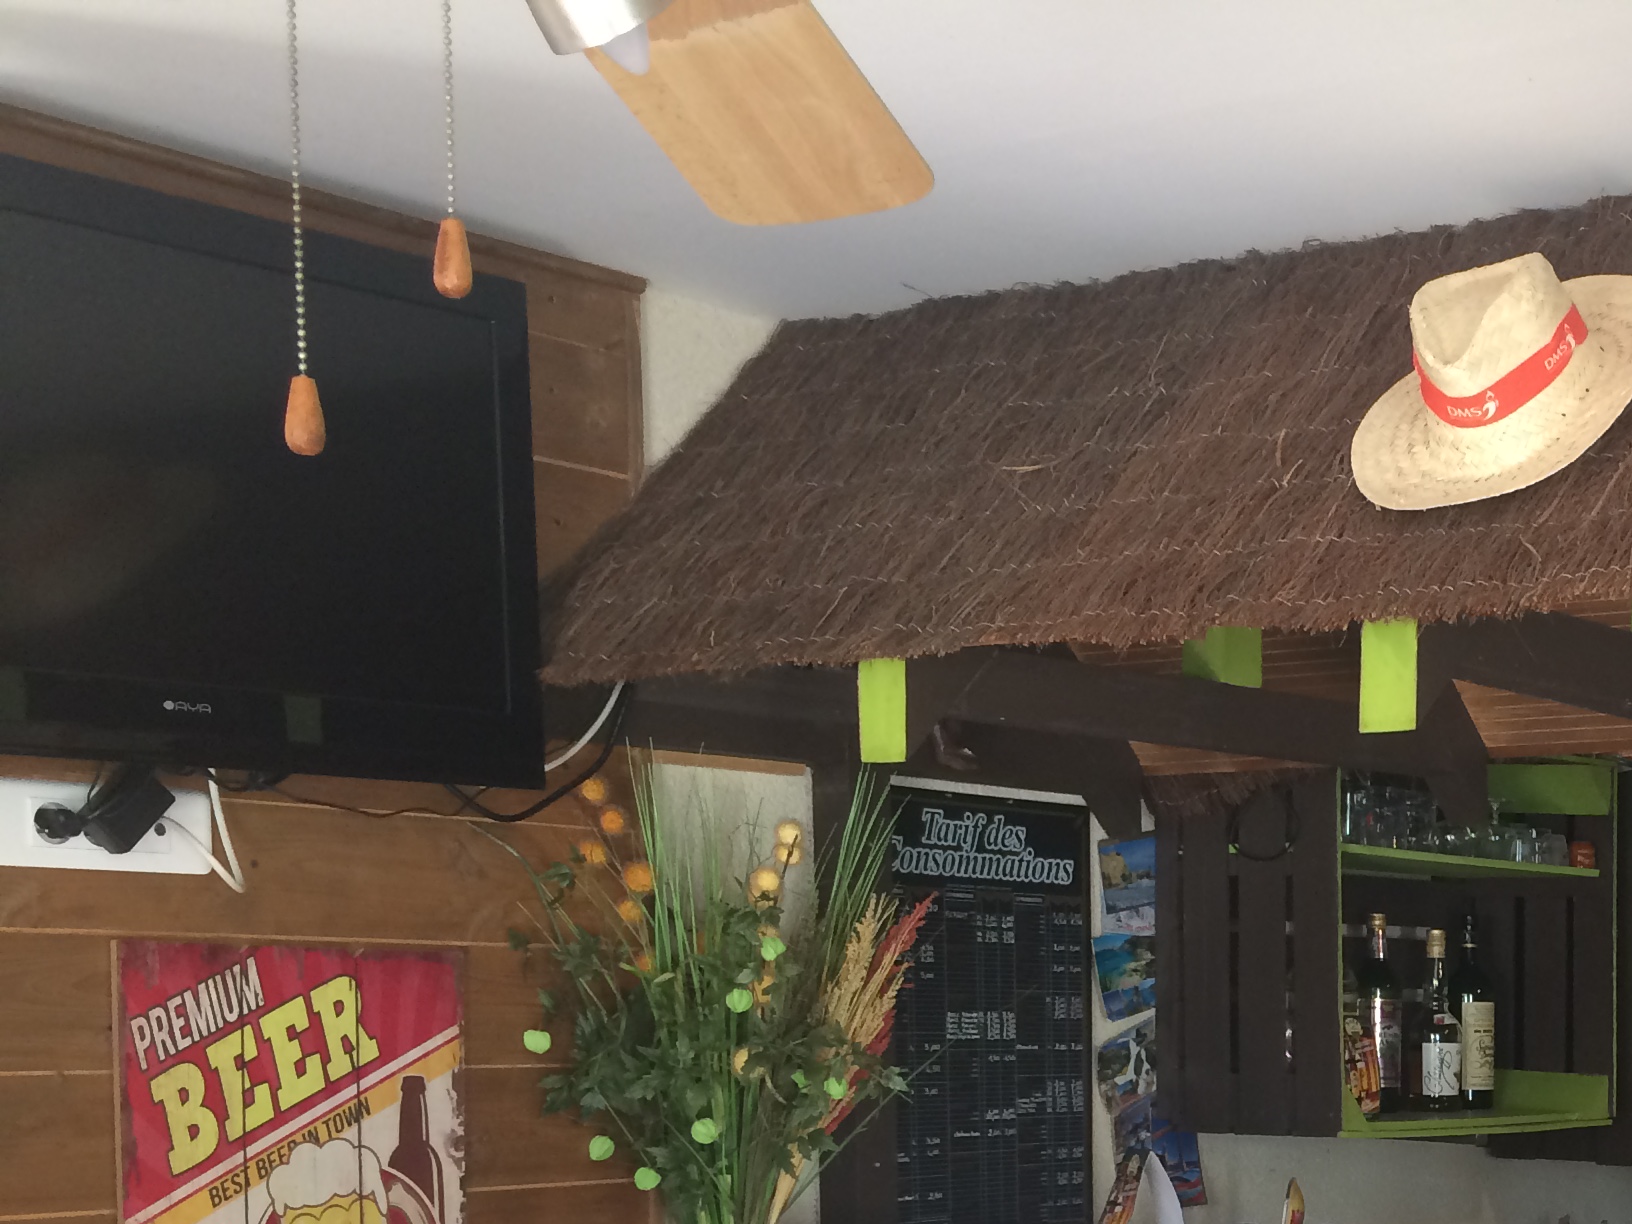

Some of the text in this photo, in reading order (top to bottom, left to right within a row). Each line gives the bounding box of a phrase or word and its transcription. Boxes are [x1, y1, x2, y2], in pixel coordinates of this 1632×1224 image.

[922, 808, 1026, 853] Tarif des
[131, 956, 264, 1070] PREMIUM
[150, 974, 379, 1176] BEER
[208, 1165, 251, 1208] BEST
[322, 1096, 371, 1139] TOWN
